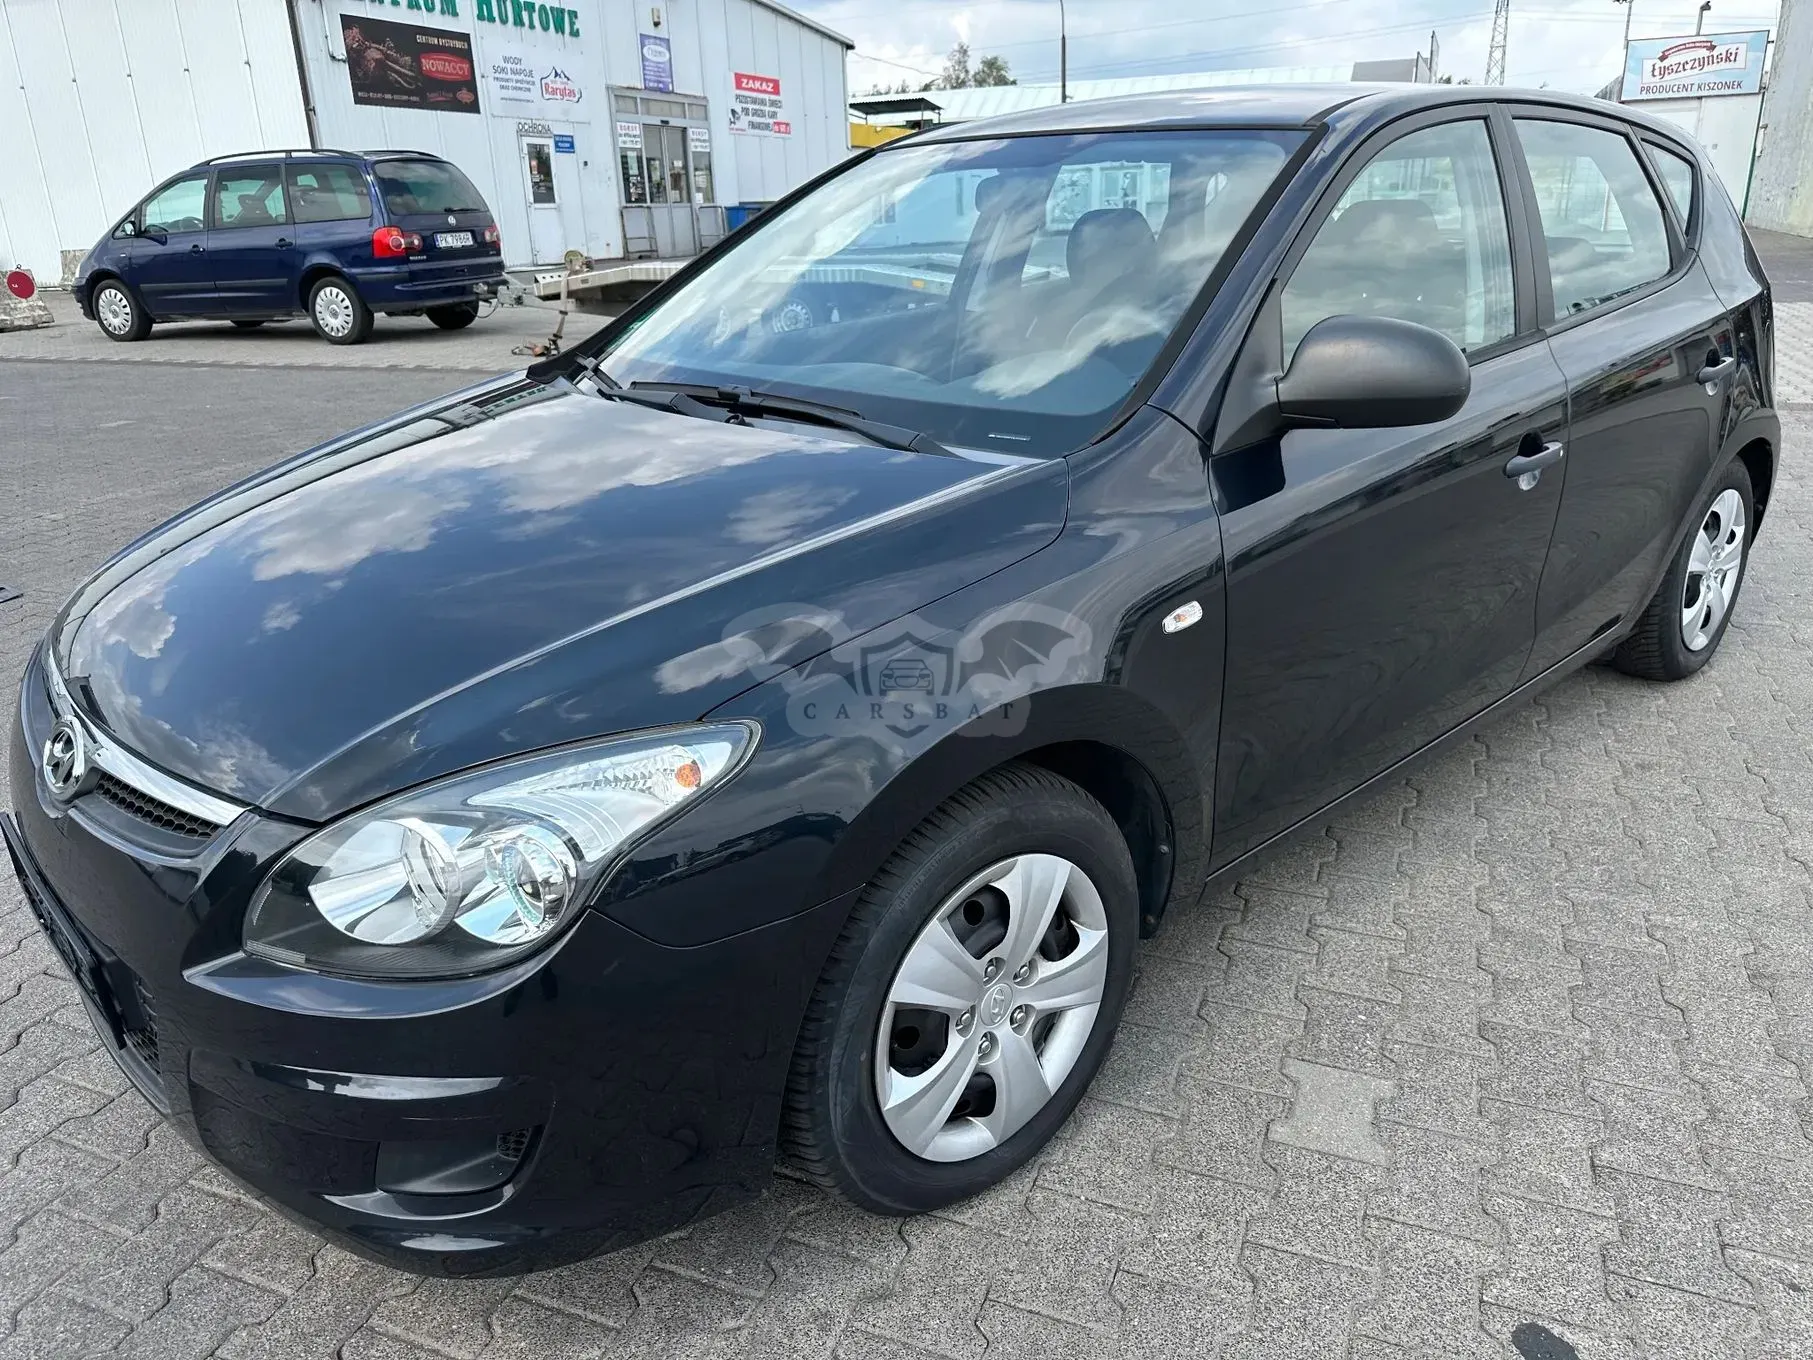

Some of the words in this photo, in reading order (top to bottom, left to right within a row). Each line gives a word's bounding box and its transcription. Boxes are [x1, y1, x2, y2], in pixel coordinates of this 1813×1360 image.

[476, 0, 580, 37] HURTOWE
[421, 58, 470, 75] NOWACCY
[502, 55, 523, 66] WODY
[492, 65, 509, 76] SOKI
[509, 67, 534, 79] NAPOJE
[544, 82, 577, 101] Rarytas
[740, 78, 774, 92] ZAKAZ
[1640, 84, 1694, 95] PRODUCENT
[1697, 80, 1744, 92] KISZONEK
[518, 121, 553, 134] OCHRONA
